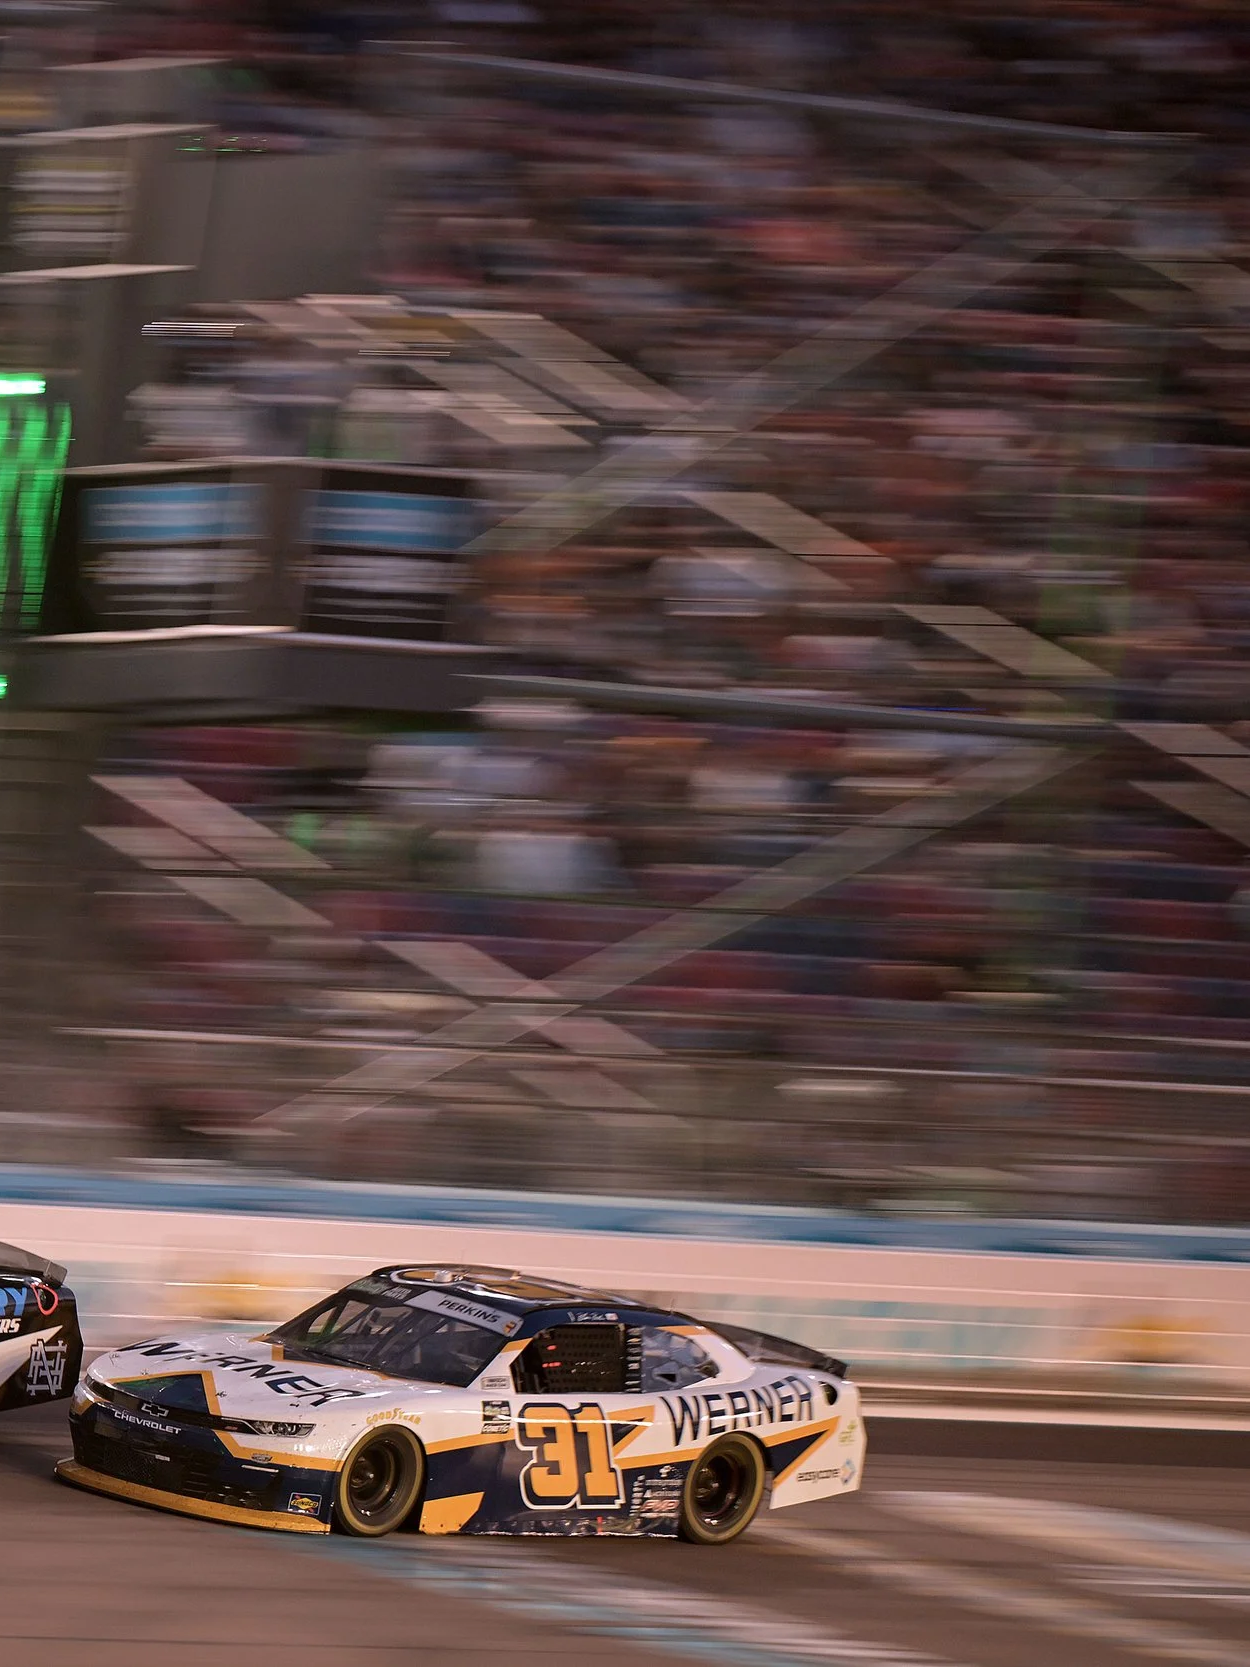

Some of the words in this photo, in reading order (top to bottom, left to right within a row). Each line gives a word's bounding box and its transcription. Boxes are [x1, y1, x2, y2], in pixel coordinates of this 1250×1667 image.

[438, 1299, 502, 1323] PERKINS
[113, 1411, 182, 1435] CHEVROLET
[366, 1408, 422, 1425] GOODYEAR
[658, 1375, 814, 1447] WERNER
[516, 1402, 627, 1510] 31
